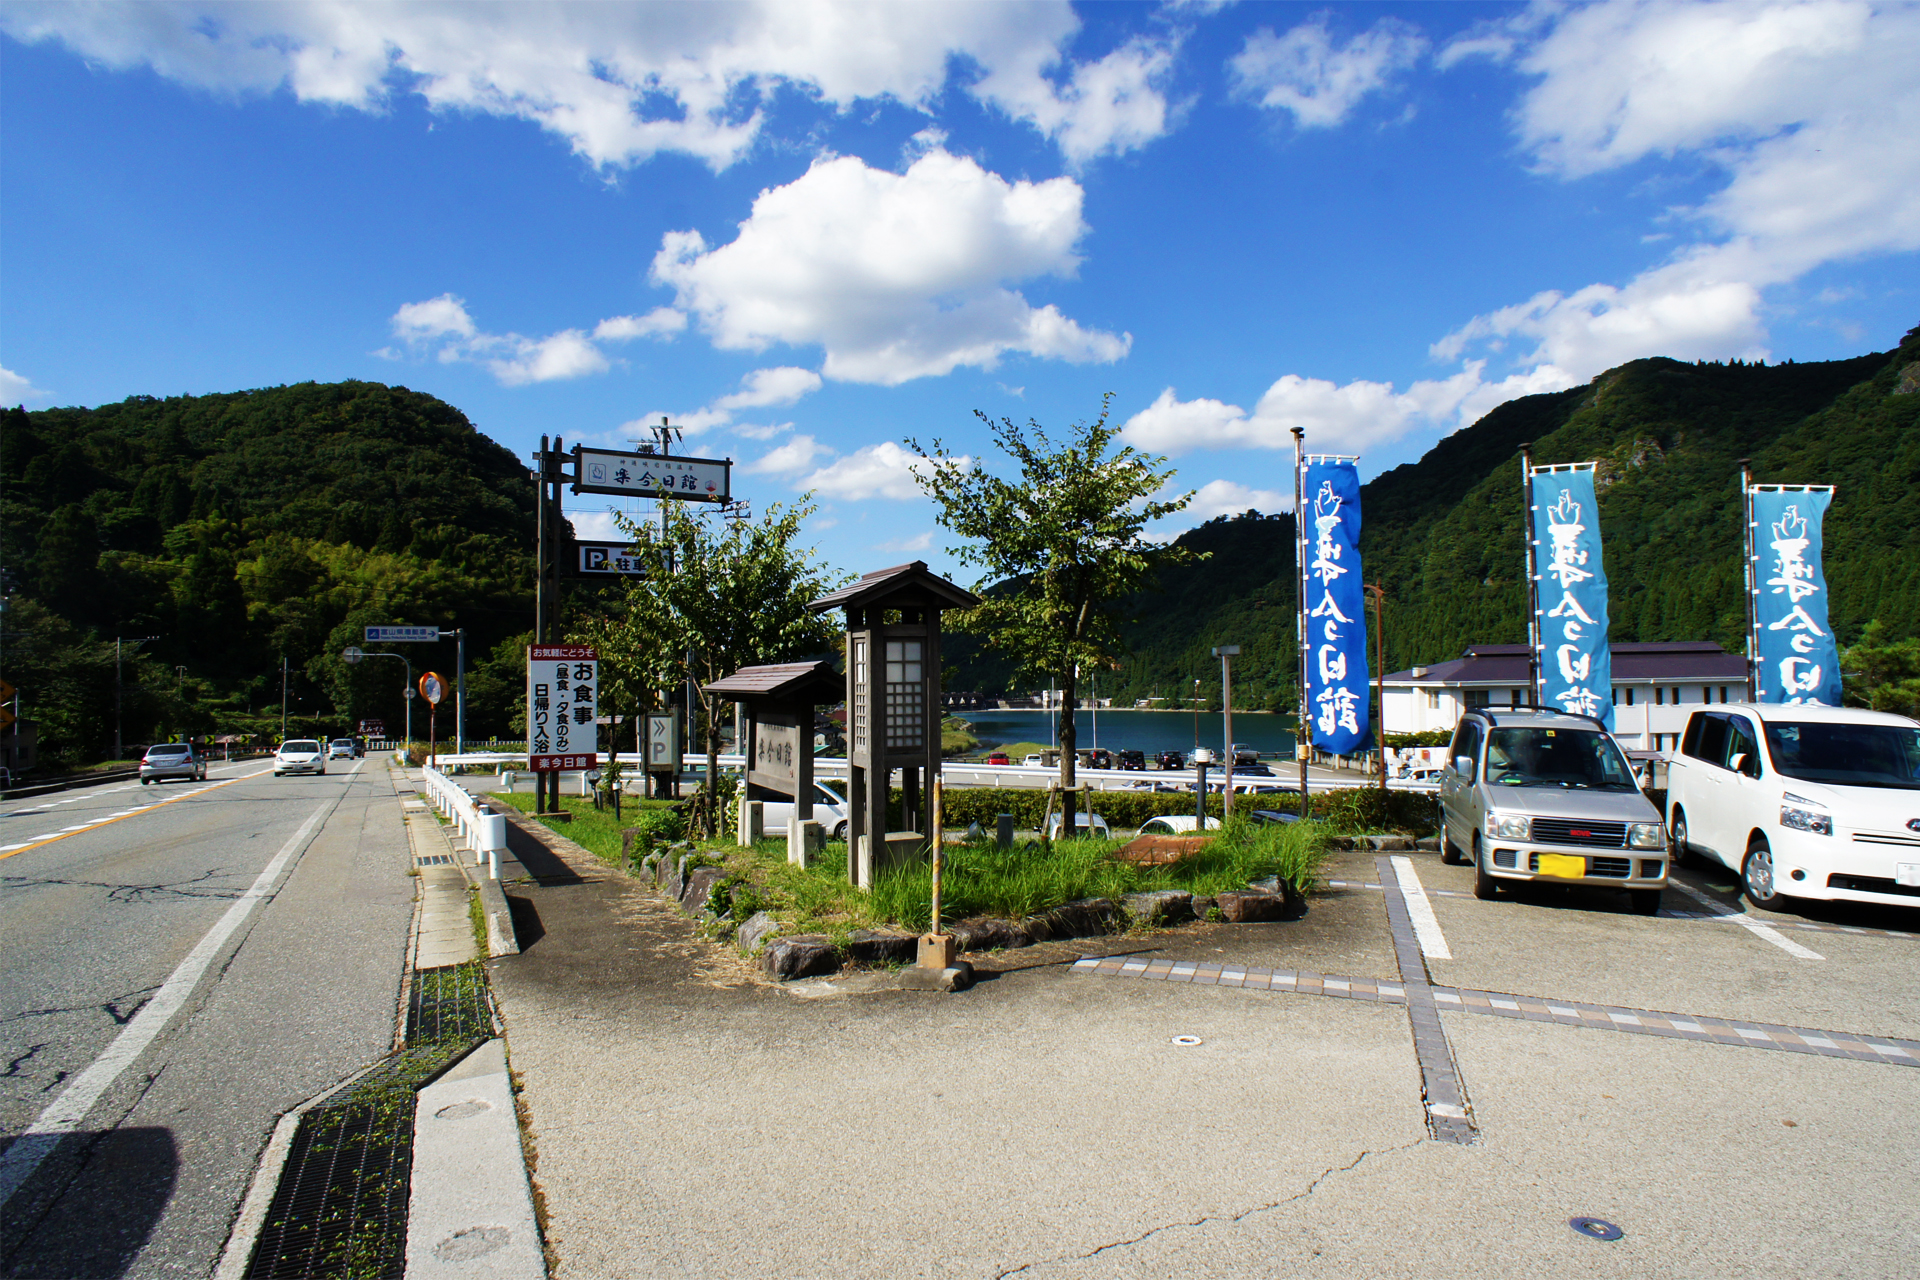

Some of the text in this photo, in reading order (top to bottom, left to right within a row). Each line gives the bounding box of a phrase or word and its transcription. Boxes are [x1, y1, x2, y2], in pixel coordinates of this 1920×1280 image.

[613, 467, 699, 491] 楽今日館
[590, 551, 604, 568] P
[1766, 538, 1829, 708] 楽今日
[573, 662, 594, 725] お食事
[534, 683, 550, 754] 日帰り入浴
[653, 742, 666, 761] P
[539, 757, 587, 769] 楽今日館
[1570, 829, 1592, 837] MOVE
